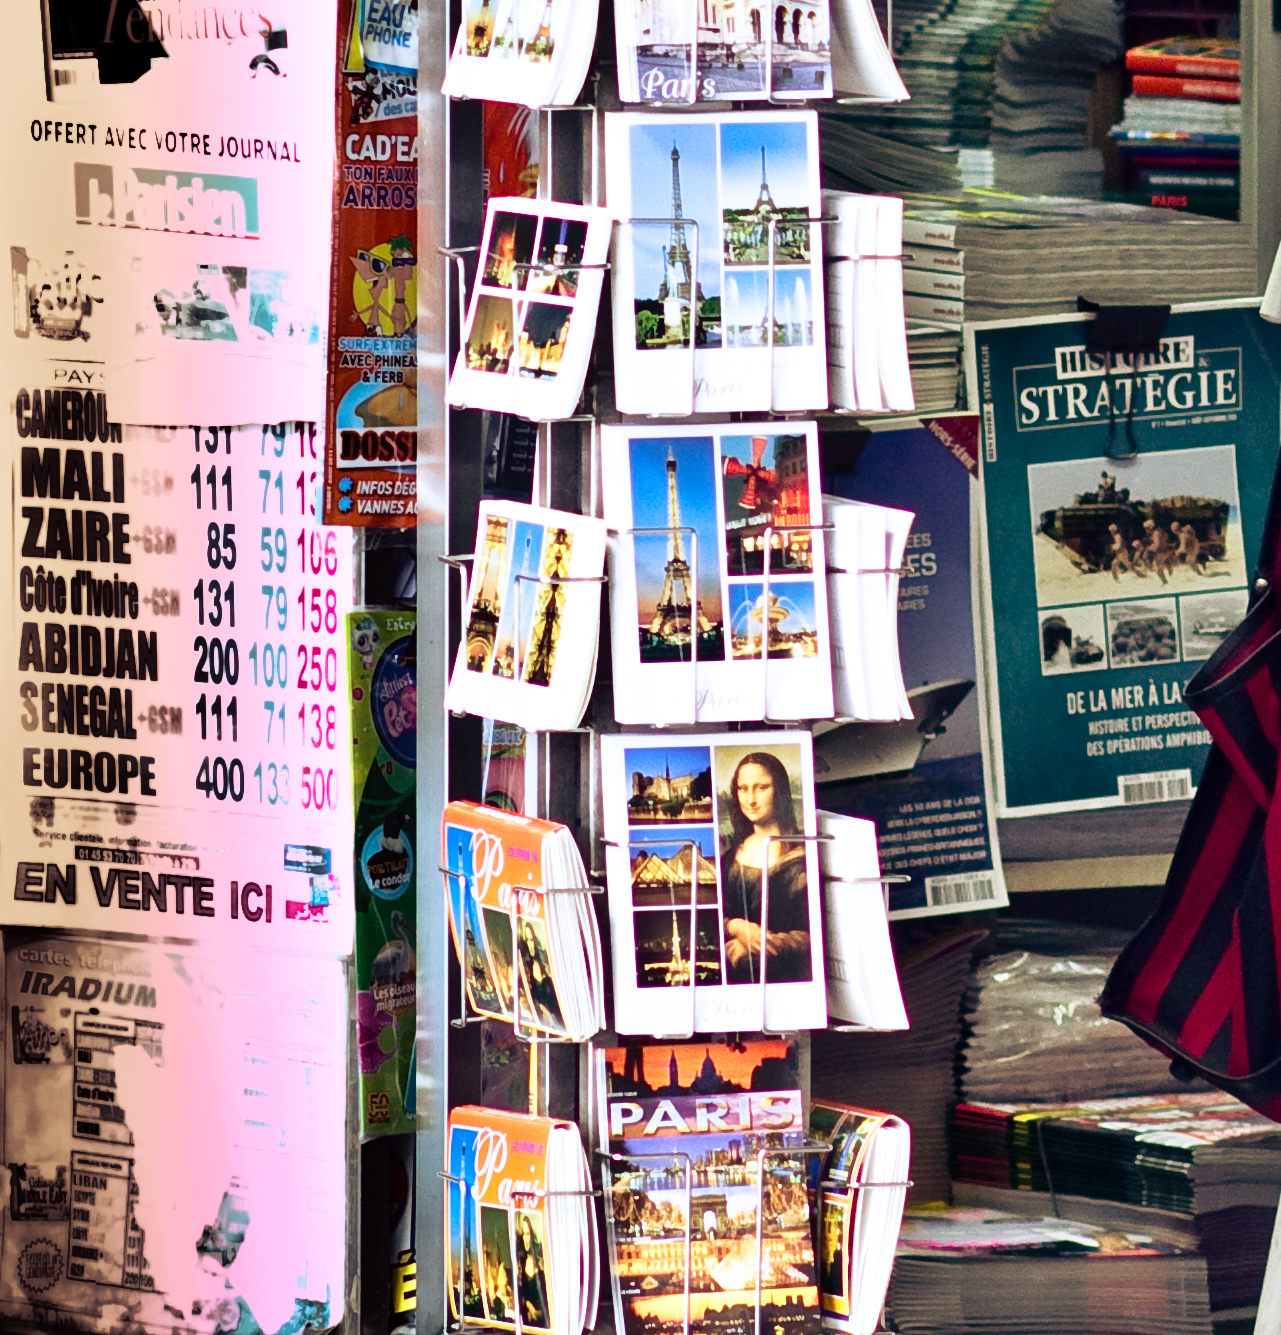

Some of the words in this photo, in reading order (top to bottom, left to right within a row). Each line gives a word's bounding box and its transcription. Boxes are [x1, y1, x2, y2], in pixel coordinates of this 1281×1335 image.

[365, 24, 412, 48] PHONE
[640, 69, 717, 101] Paris
[31, 119, 97, 146] OFFERT
[105, 126, 147, 150] AVEC
[154, 131, 211, 155] VOTRE
[218, 135, 301, 164] JOURNAL
[343, 165, 374, 182] TON
[1151, 195, 1188, 207] PARIS
[373, 371, 404, 383] FERB
[1020, 369, 1237, 425] STRATÉGIE
[20, 447, 126, 504] MALI
[21, 507, 132, 565] ZAIRE
[207, 521, 237, 570] 85
[19, 566, 66, 614] Côte
[18, 621, 159, 682] ABIDJAN
[194, 636, 239, 686] 200
[19, 681, 137, 740] SENEGAL
[1067, 691, 1086, 714] DE
[1089, 689, 1108, 712] LA
[1111, 685, 1144, 710] MER
[1163, 681, 1182, 704] LA
[1087, 741, 1104, 757] DES
[1107, 735, 1164, 754] OPÉRATIONS
[1089, 717, 1130, 736] HISTOIRE
[1132, 716, 1143, 731] ET
[22, 747, 157, 797] EUROPE
[195, 756, 245, 803] 400
[14, 862, 76, 905] EN
[90, 866, 215, 917] VENTE
[230, 881, 273, 923] ICI
[20, 970, 157, 1008] IRADIUM
[611, 1094, 797, 1138] PARIS
